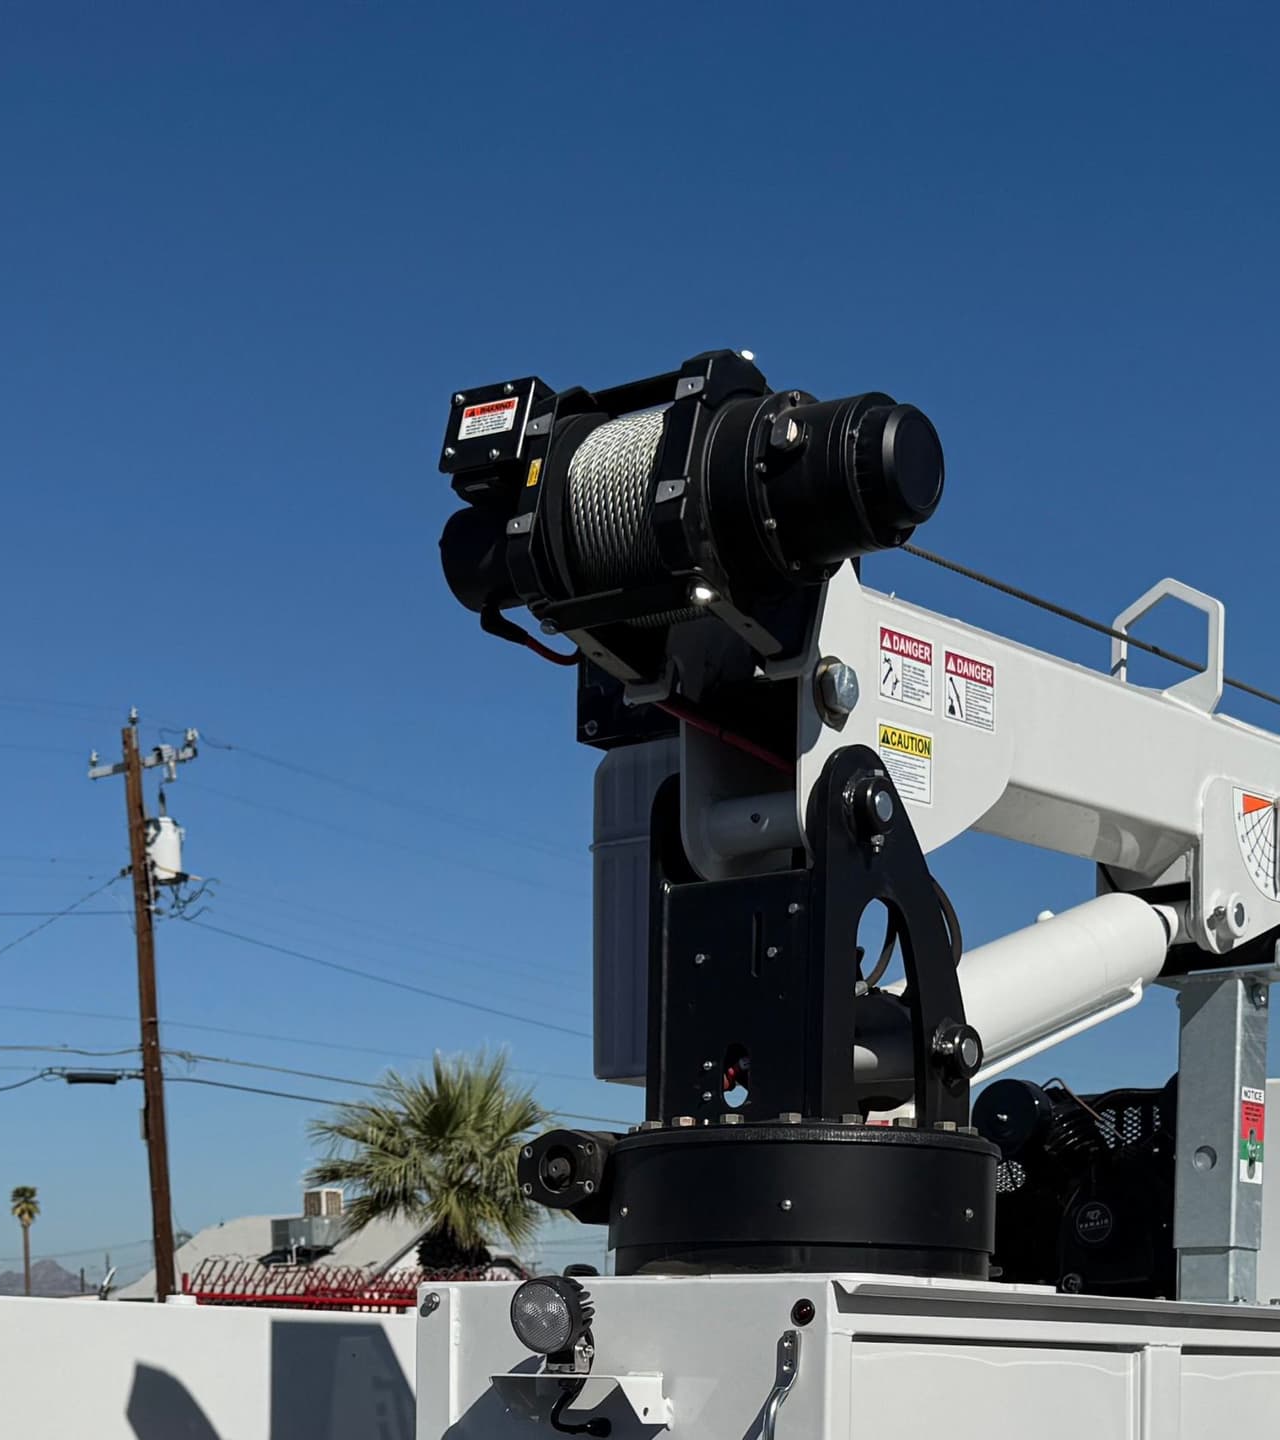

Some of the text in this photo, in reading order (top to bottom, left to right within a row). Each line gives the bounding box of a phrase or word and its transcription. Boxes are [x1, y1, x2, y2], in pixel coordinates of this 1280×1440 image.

[893, 636, 931, 662] DANGER
[957, 665, 993, 684] DANGER
[890, 731, 930, 755] CAUTION
[1243, 1089, 1263, 1102] NOTICE
